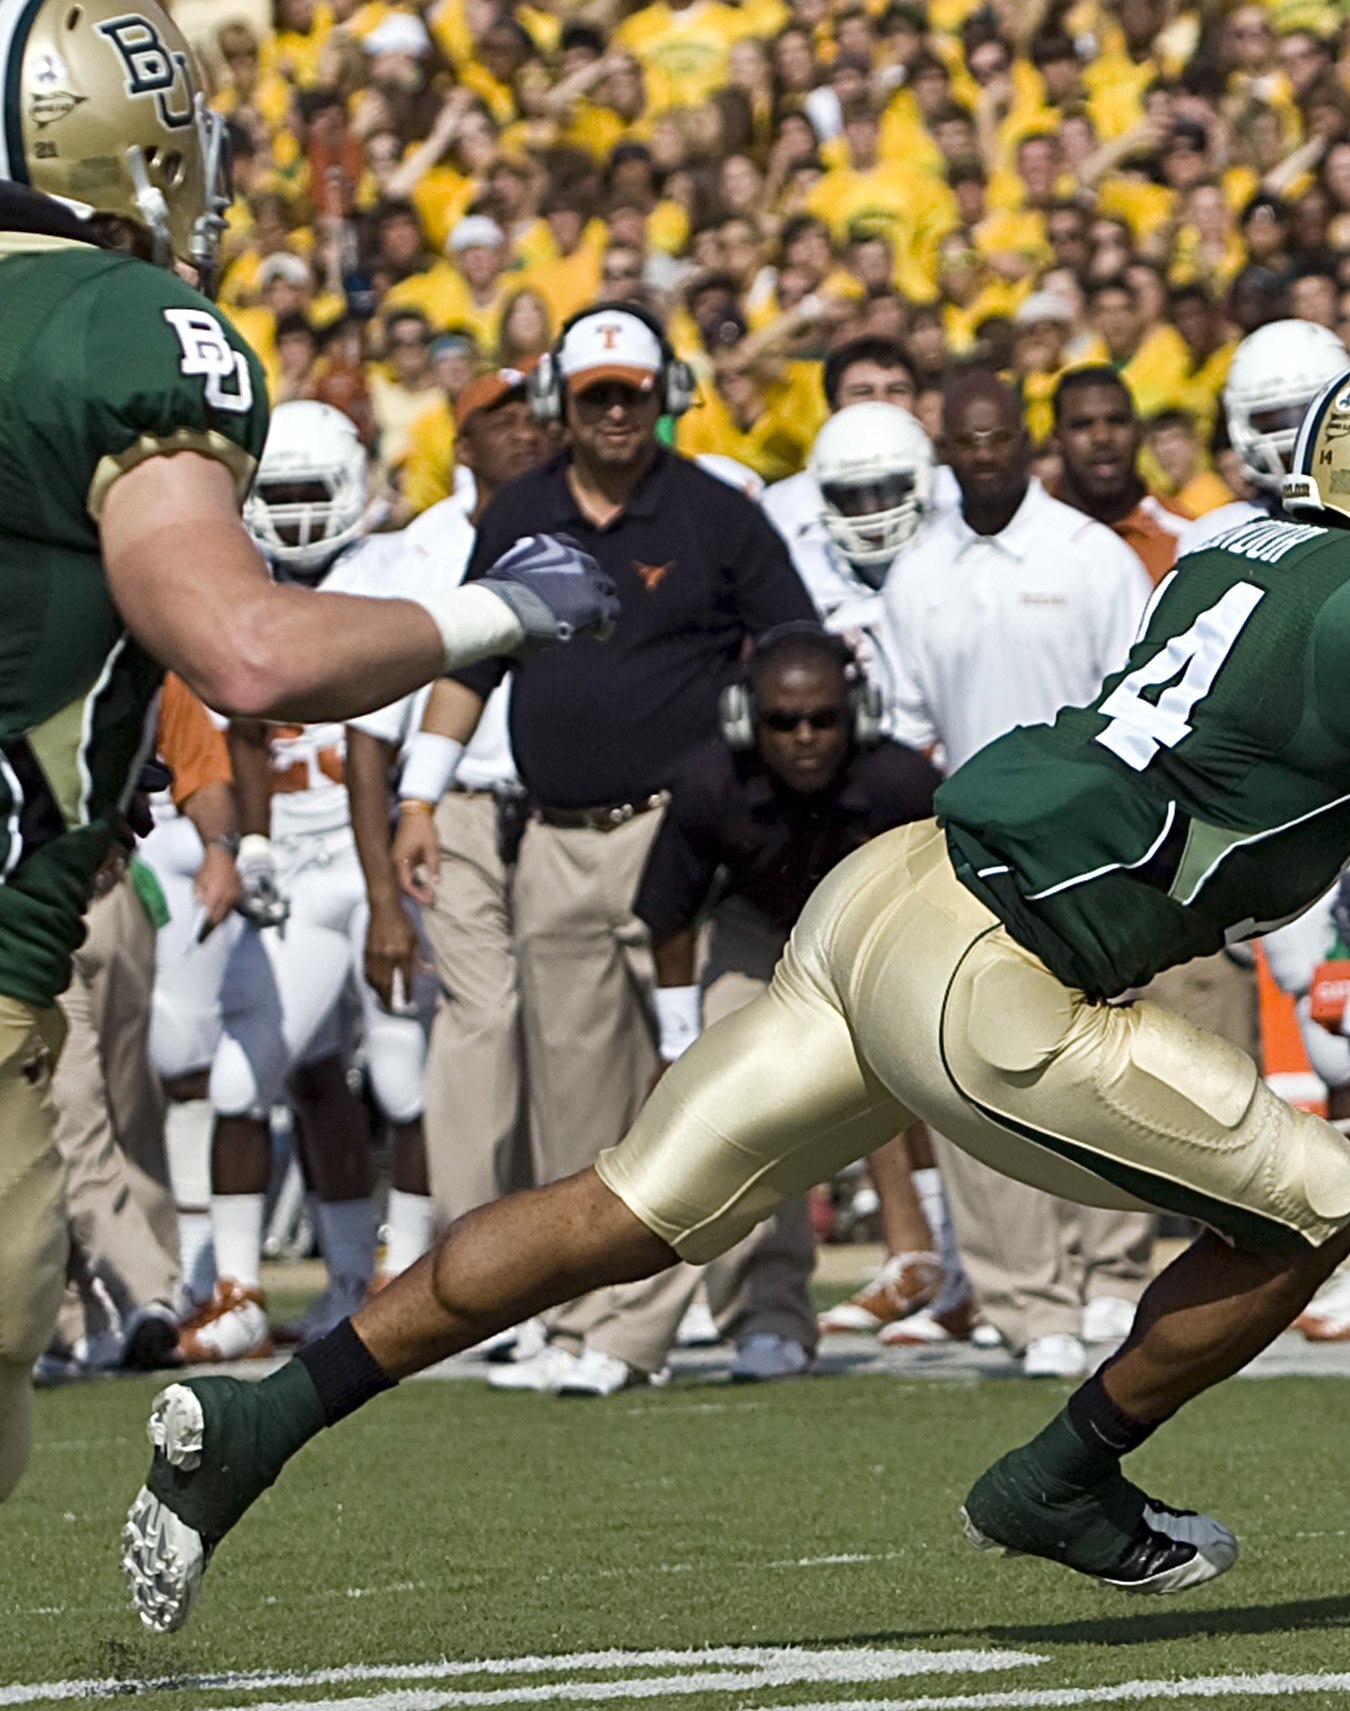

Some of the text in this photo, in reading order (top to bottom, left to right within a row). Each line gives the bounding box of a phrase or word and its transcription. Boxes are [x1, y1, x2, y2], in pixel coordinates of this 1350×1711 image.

[93, 13, 193, 132] BU
[163, 308, 253, 413] BU
[596, 324, 622, 350] T
[1319, 449, 1333, 465] 14
